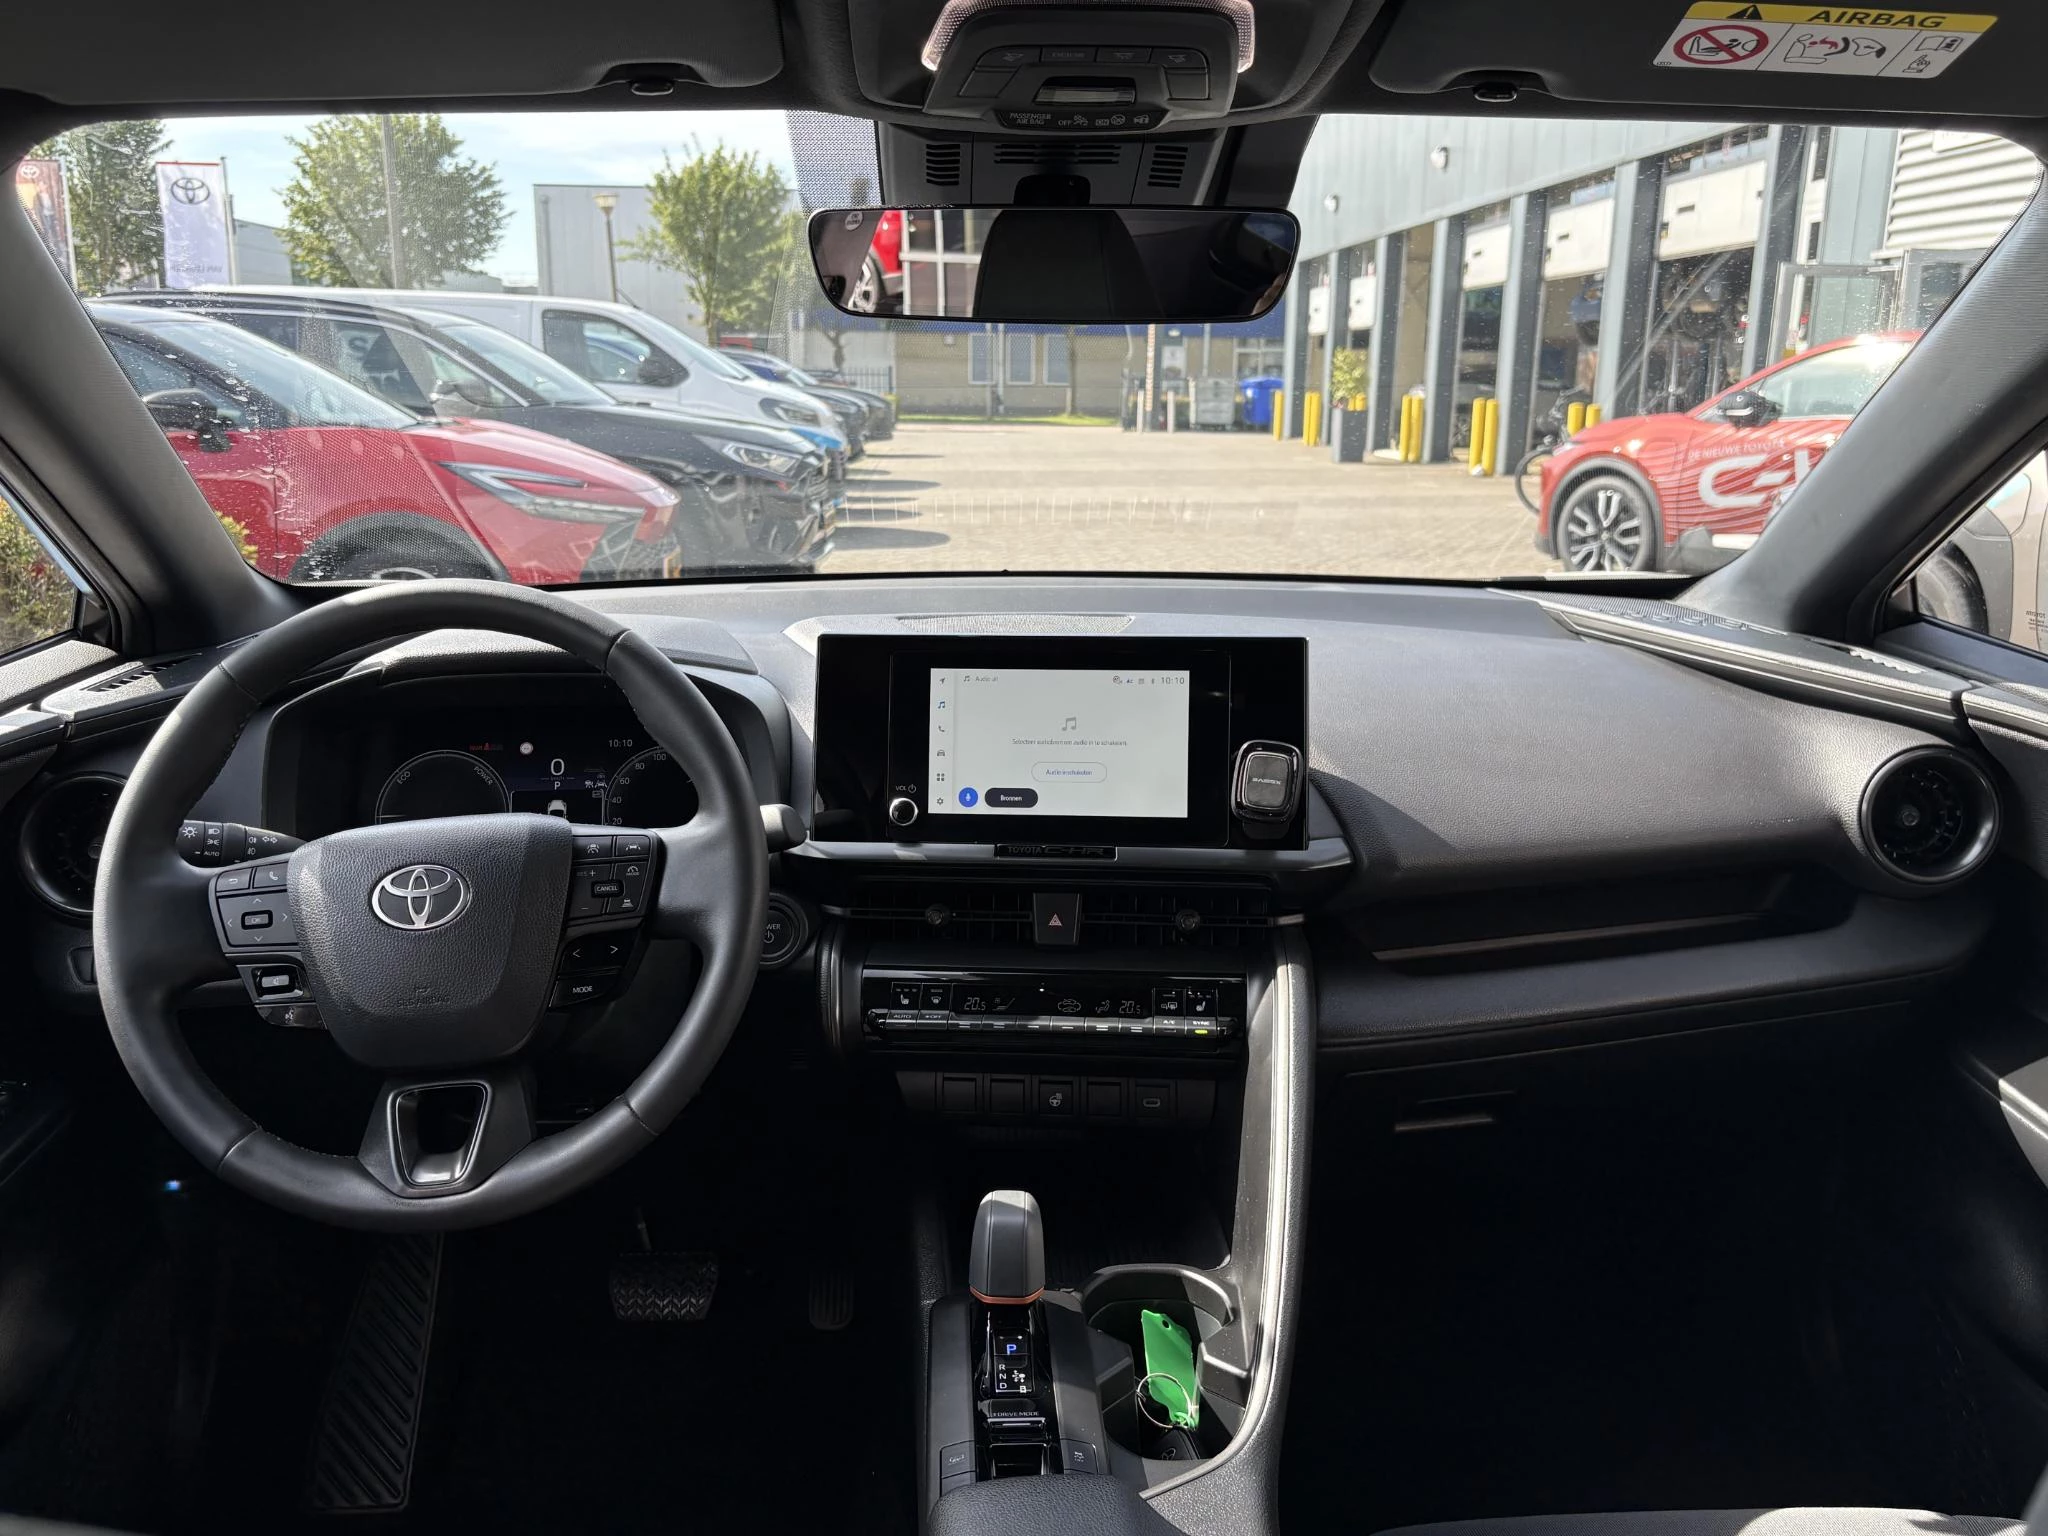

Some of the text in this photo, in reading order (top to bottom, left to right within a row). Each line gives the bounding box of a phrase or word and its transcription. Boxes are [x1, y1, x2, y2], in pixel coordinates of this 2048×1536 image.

[1806, 9, 1947, 29] AIRBAG
[1009, 112, 1052, 120] PASSENGER
[1016, 118, 1029, 126] AIR
[1703, 444, 1743, 457] NIEUWE
[1743, 437, 1786, 451] TOYOTA
[1161, 676, 1185, 685] 10:10
[608, 739, 633, 748] 10:10
[652, 753, 667, 761] 100
[550, 758, 565, 776] 0
[634, 762, 645, 770] 80
[396, 770, 411, 785] ECO
[473, 766, 494, 786] POWER
[554, 781, 561, 790] P
[619, 777, 630, 785] 60
[611, 796, 622, 804] 40
[1000, 793, 1023, 802] Bronnen
[612, 817, 623, 825] 20
[1007, 846, 1042, 855] TOYOTA
[596, 884, 618, 892] CANCEL
[572, 985, 593, 993] MODE
[964, 996, 986, 1011] 20.5
[1119, 1000, 1141, 1015] 20.5
[1006, 1343, 1017, 1356] P
[998, 1363, 1006, 1371] R
[1020, 1385, 1027, 1394] B
